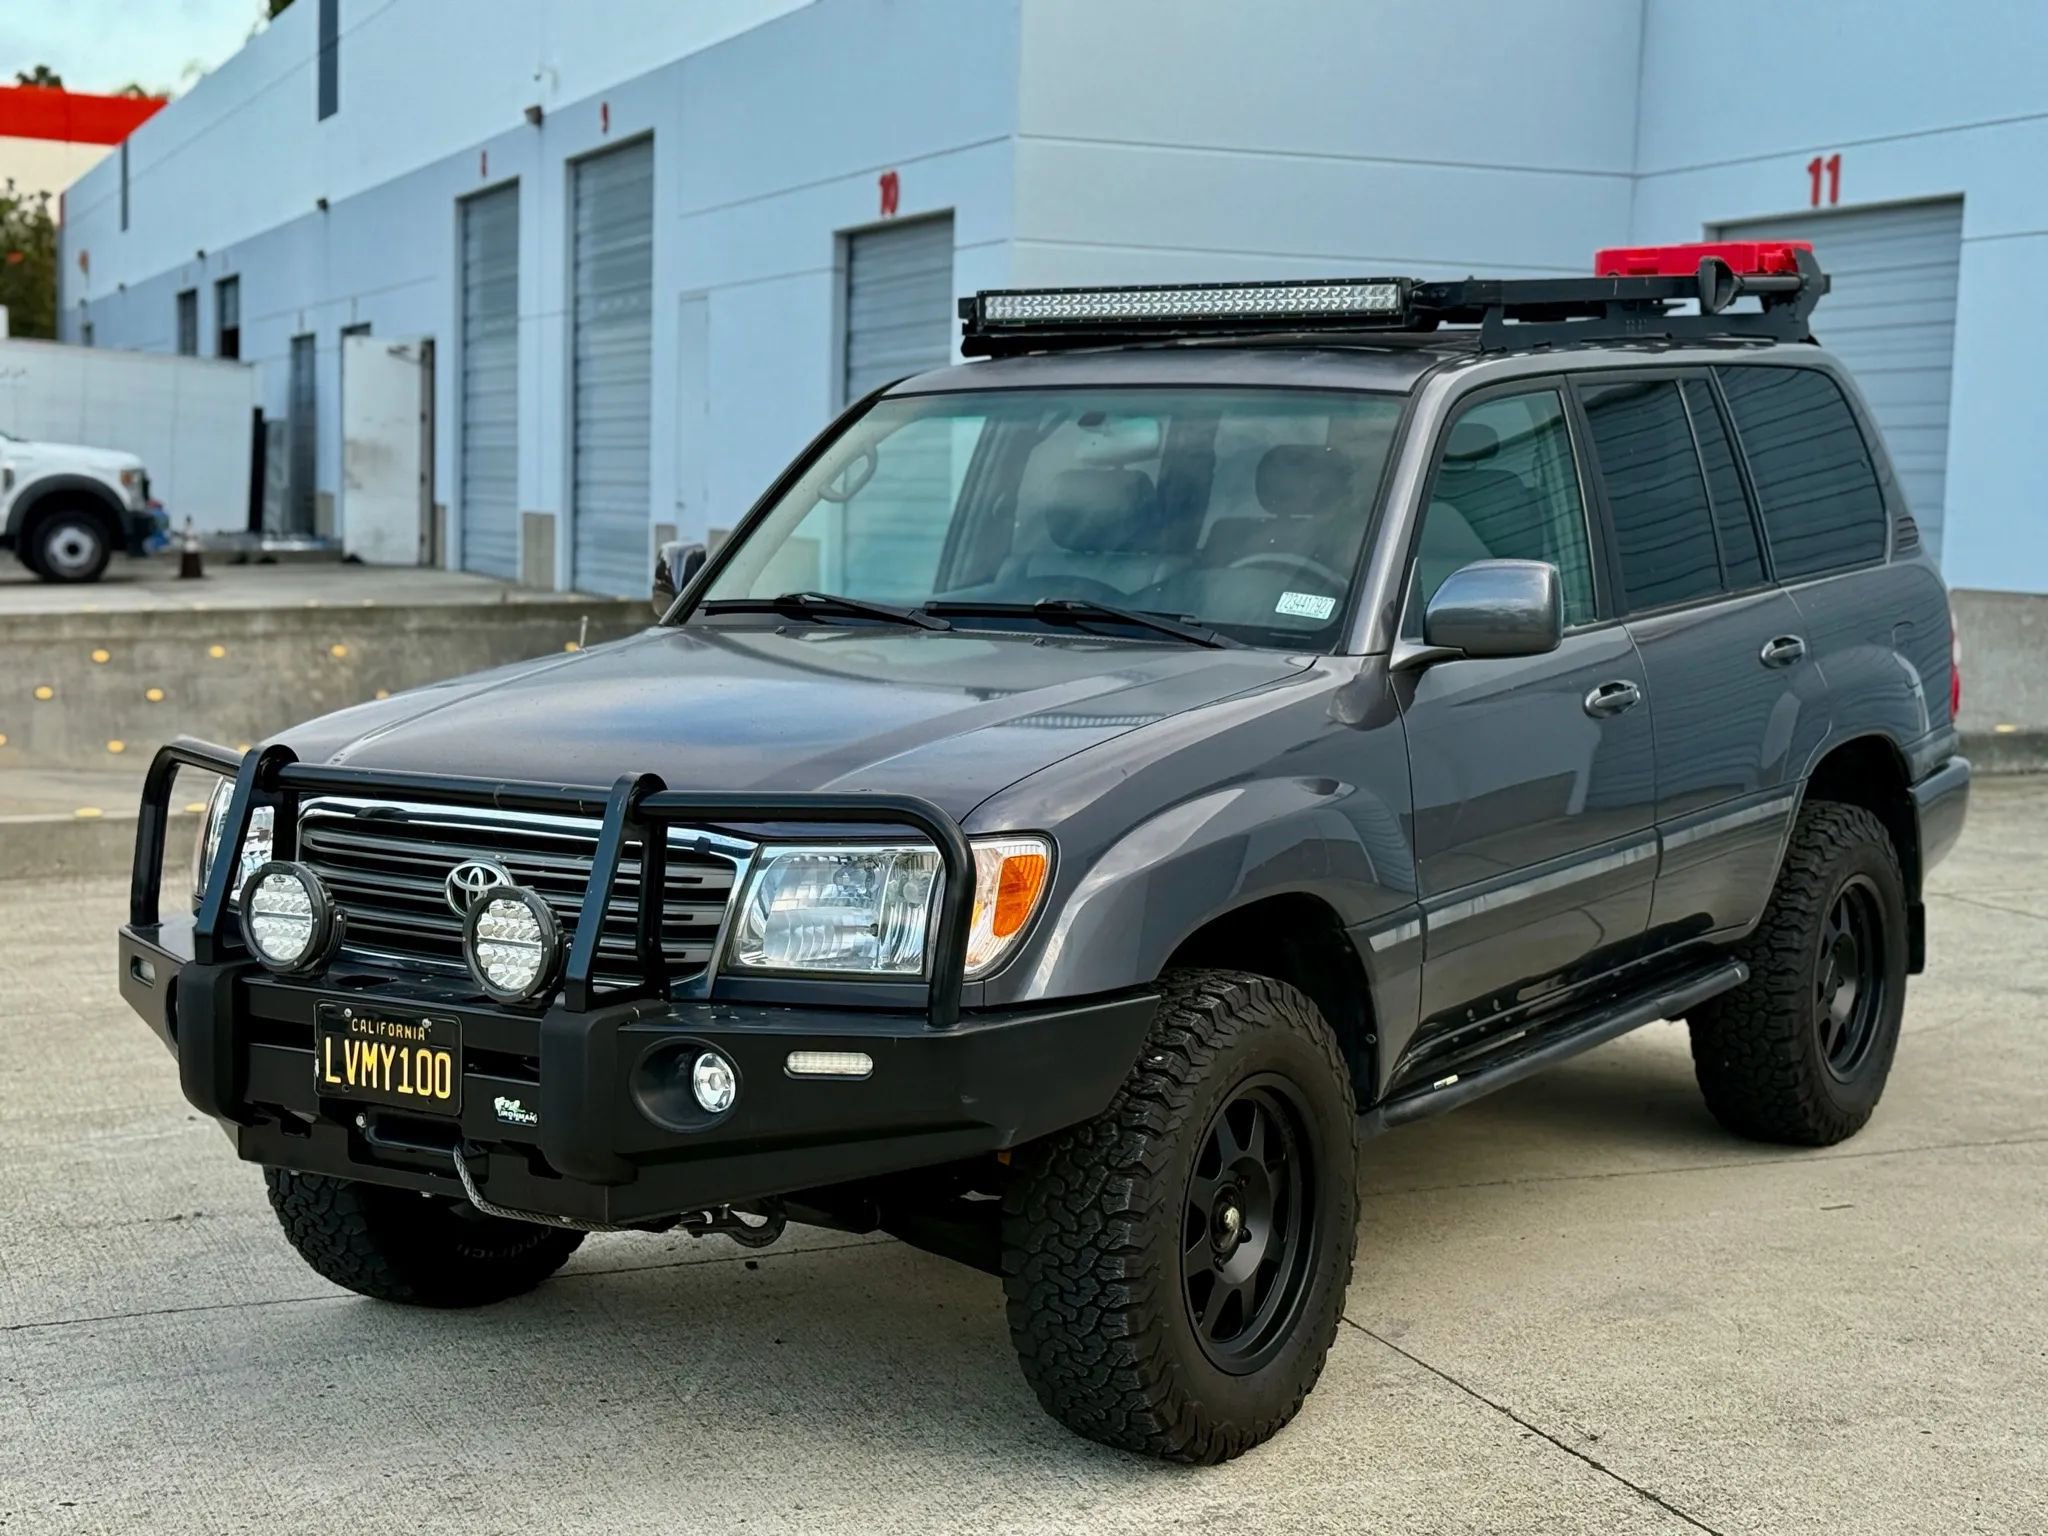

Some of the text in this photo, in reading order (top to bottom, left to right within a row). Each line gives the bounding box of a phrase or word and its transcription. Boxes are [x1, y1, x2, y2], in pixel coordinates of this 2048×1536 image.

[879, 171, 899, 216] 10
[1807, 153, 1841, 207] 11
[351, 1018, 426, 1041] CALIFORNIA
[324, 1036, 452, 1099] LVMY100
